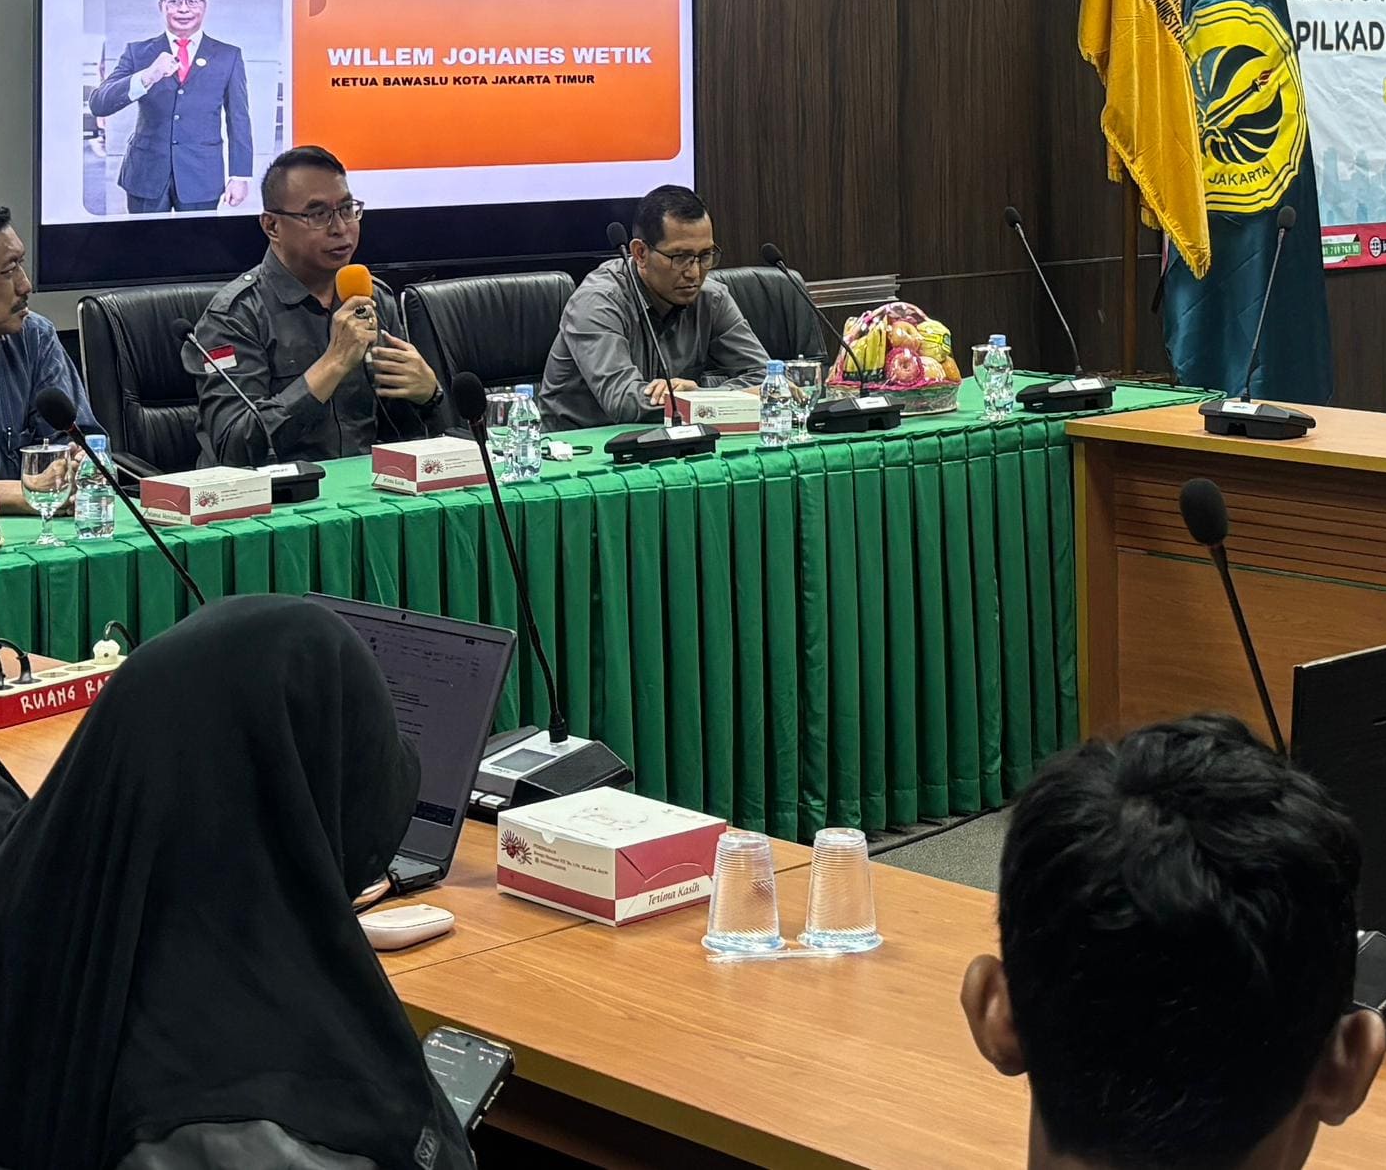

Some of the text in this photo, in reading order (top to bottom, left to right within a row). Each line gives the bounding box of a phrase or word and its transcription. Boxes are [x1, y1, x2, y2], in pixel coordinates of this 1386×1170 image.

[327, 46, 652, 66] WILLEM JOHANES WETIK
[331, 74, 595, 87] KETUA BAWASLU KOTA JAKARTA TIMUR
[1208, 166, 1271, 186] JAKARTA
[20, 685, 76, 714] RUANG
[647, 883, 701, 906] Terima Kasih
